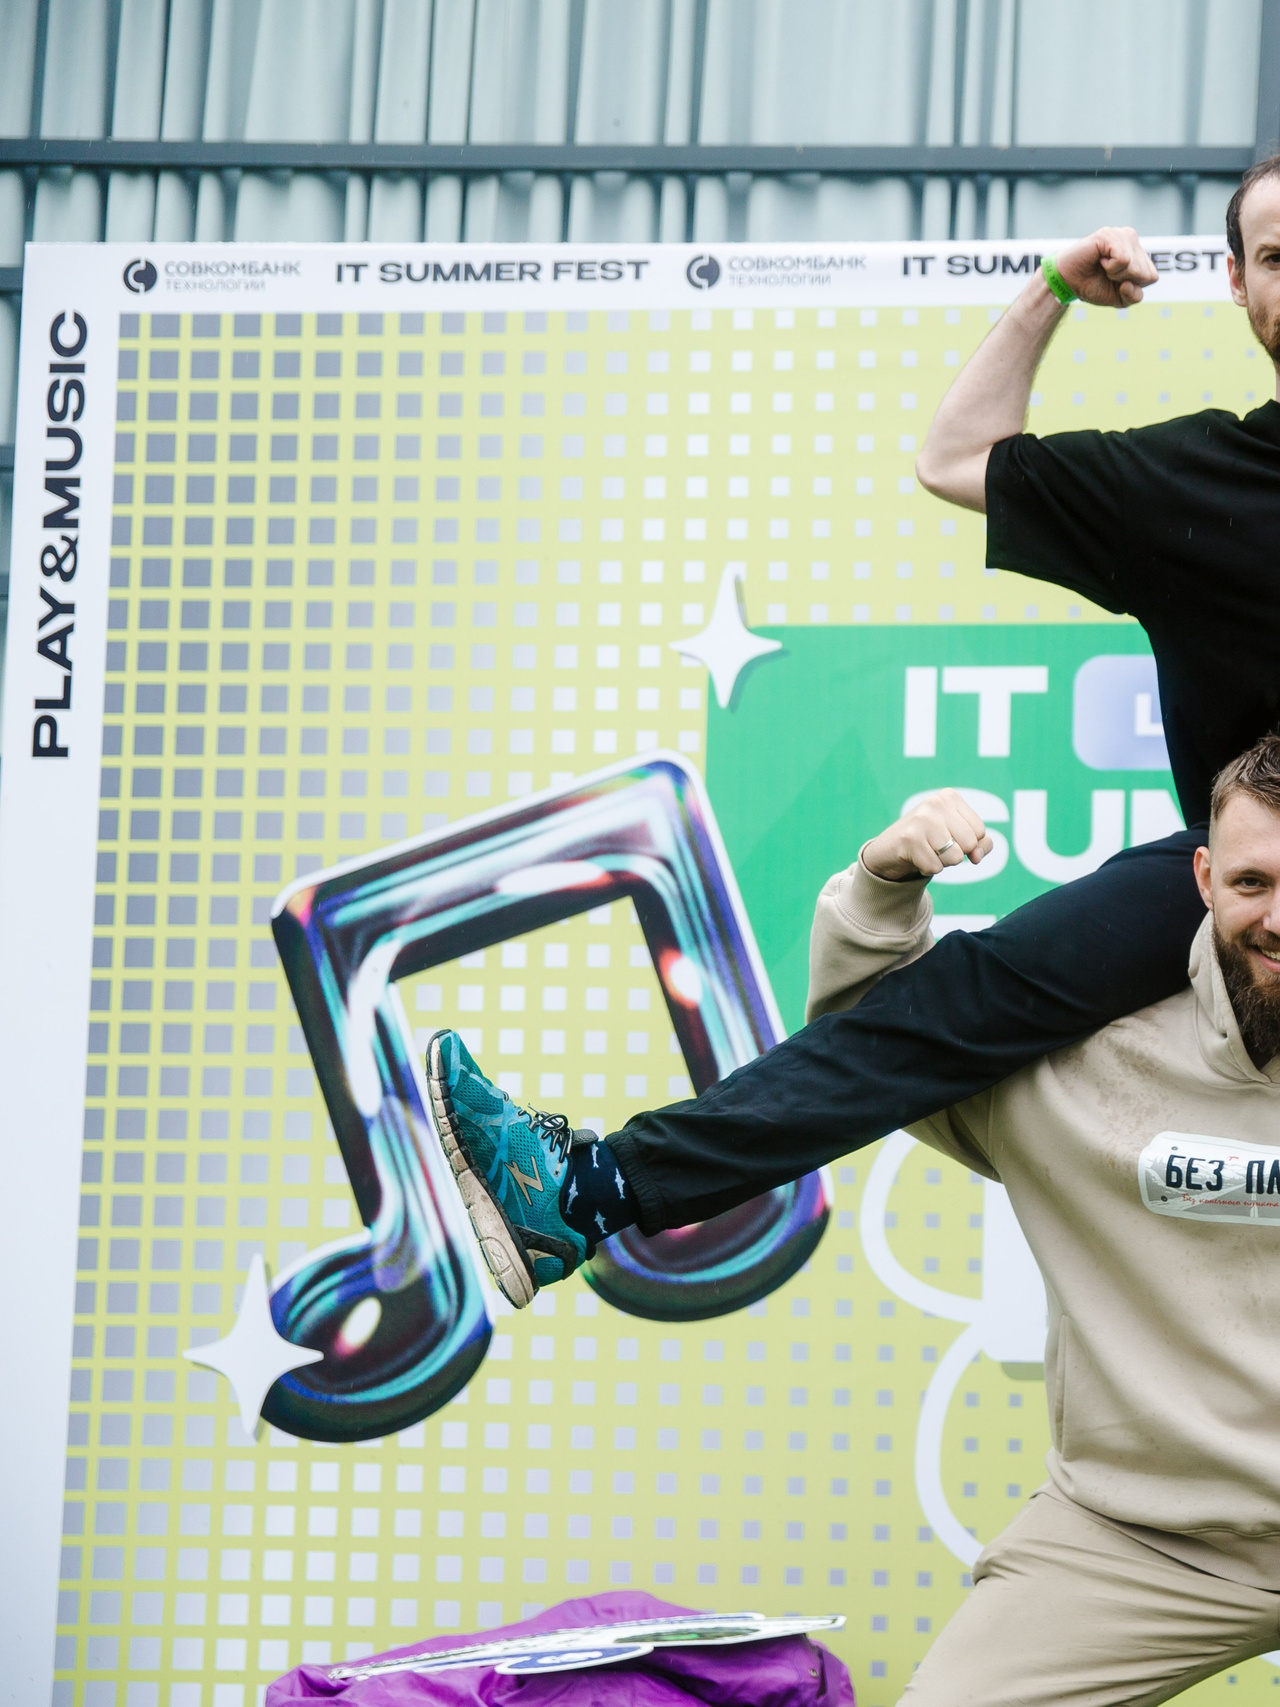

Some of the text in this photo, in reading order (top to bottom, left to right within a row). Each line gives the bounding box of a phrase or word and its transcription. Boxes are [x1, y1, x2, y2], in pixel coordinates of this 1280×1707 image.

[164, 260, 302, 278] СОВКОМБАНК
[336, 260, 651, 284] IT SUMMER FEST
[728, 255, 867, 272] СОВКОМБАНК
[902, 255, 936, 276] IT
[1150, 250, 1225, 272] EST
[165, 279, 266, 293] ТЕХНОЛОГИИ
[729, 273, 832, 287] ТЕХНОЛОГИИ
[31, 310, 88, 759] PLAY&MUSIC
[903, 665, 1049, 758] IT
[1165, 1154, 1225, 1192] БЕЗ
